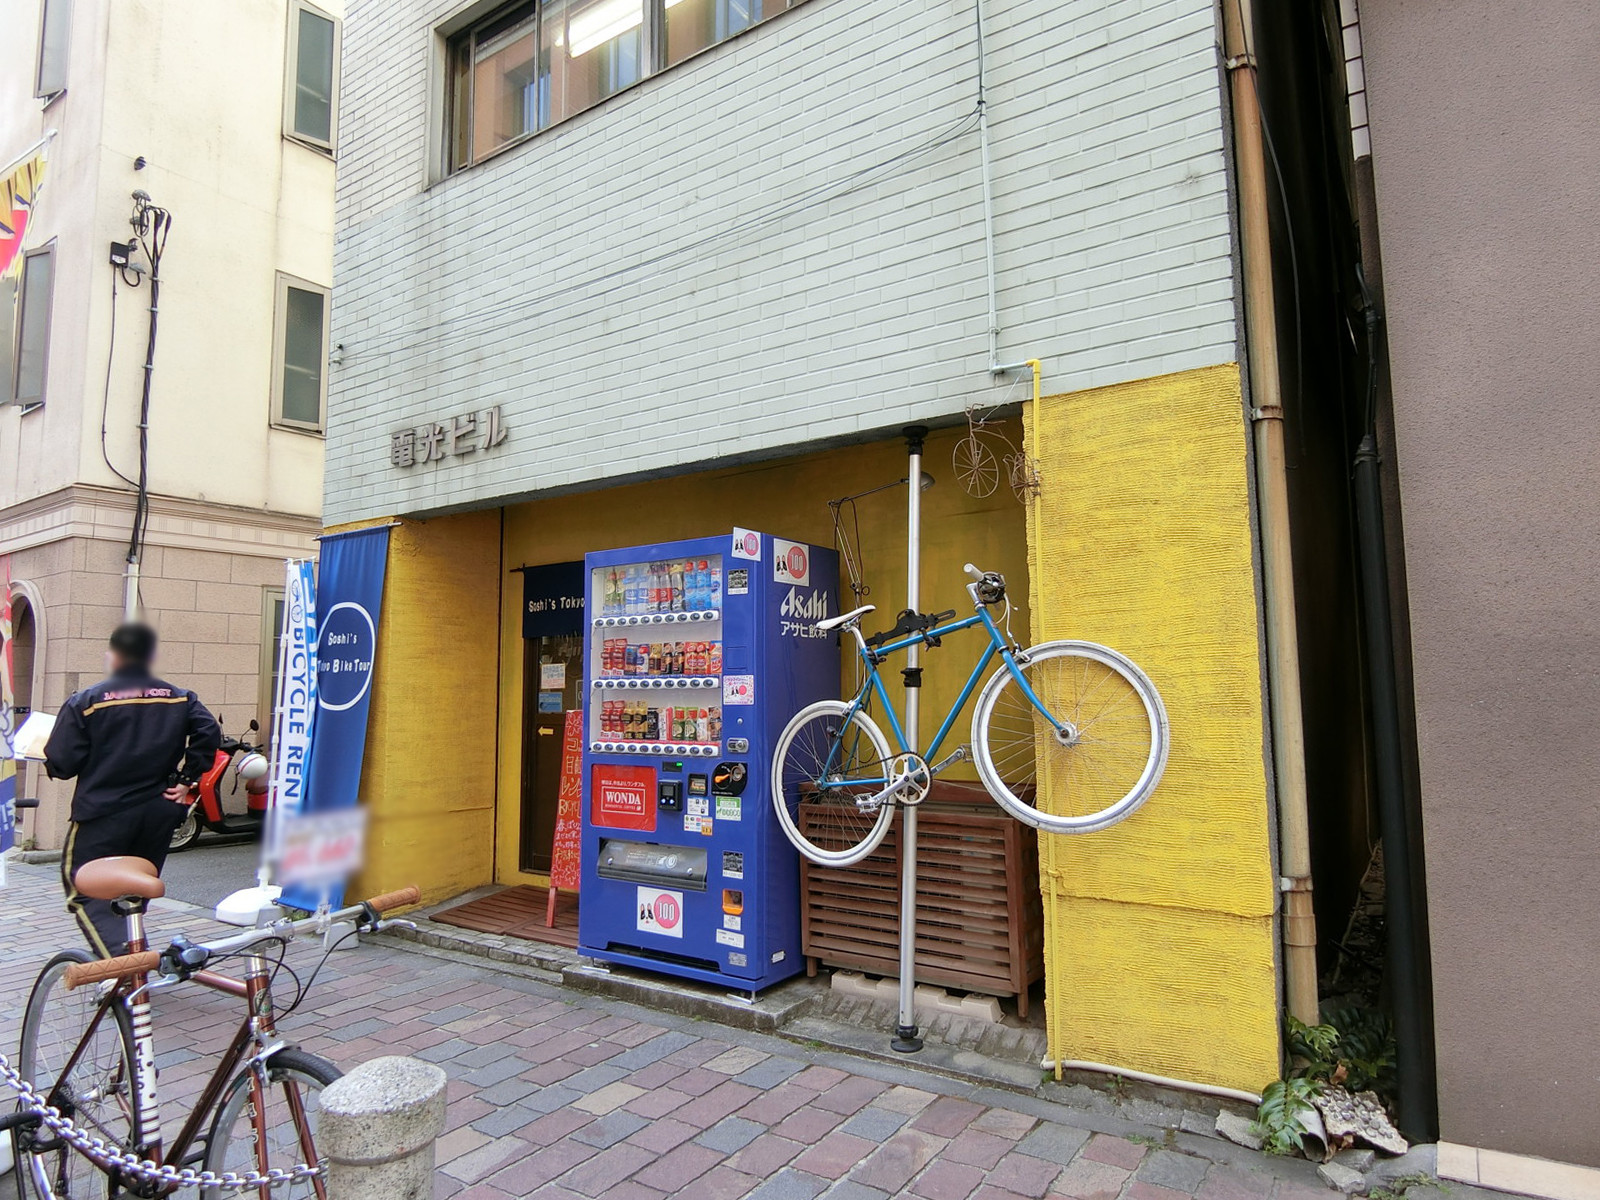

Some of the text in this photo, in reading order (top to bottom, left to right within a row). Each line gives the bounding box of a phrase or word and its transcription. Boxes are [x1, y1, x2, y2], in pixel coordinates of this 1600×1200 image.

[391, 405, 509, 467] 電光ビル
[791, 554, 803, 571] 100
[528, 596, 585, 613] Soshi's Tokyo
[780, 586, 828, 620] Asahi
[328, 632, 357, 646] Soshi's
[332, 658, 353, 673] Bike
[354, 658, 371, 673] Tour
[289, 628, 306, 734] BICYCLE
[605, 791, 641, 805] WONDA
[659, 902, 675, 921] 100
